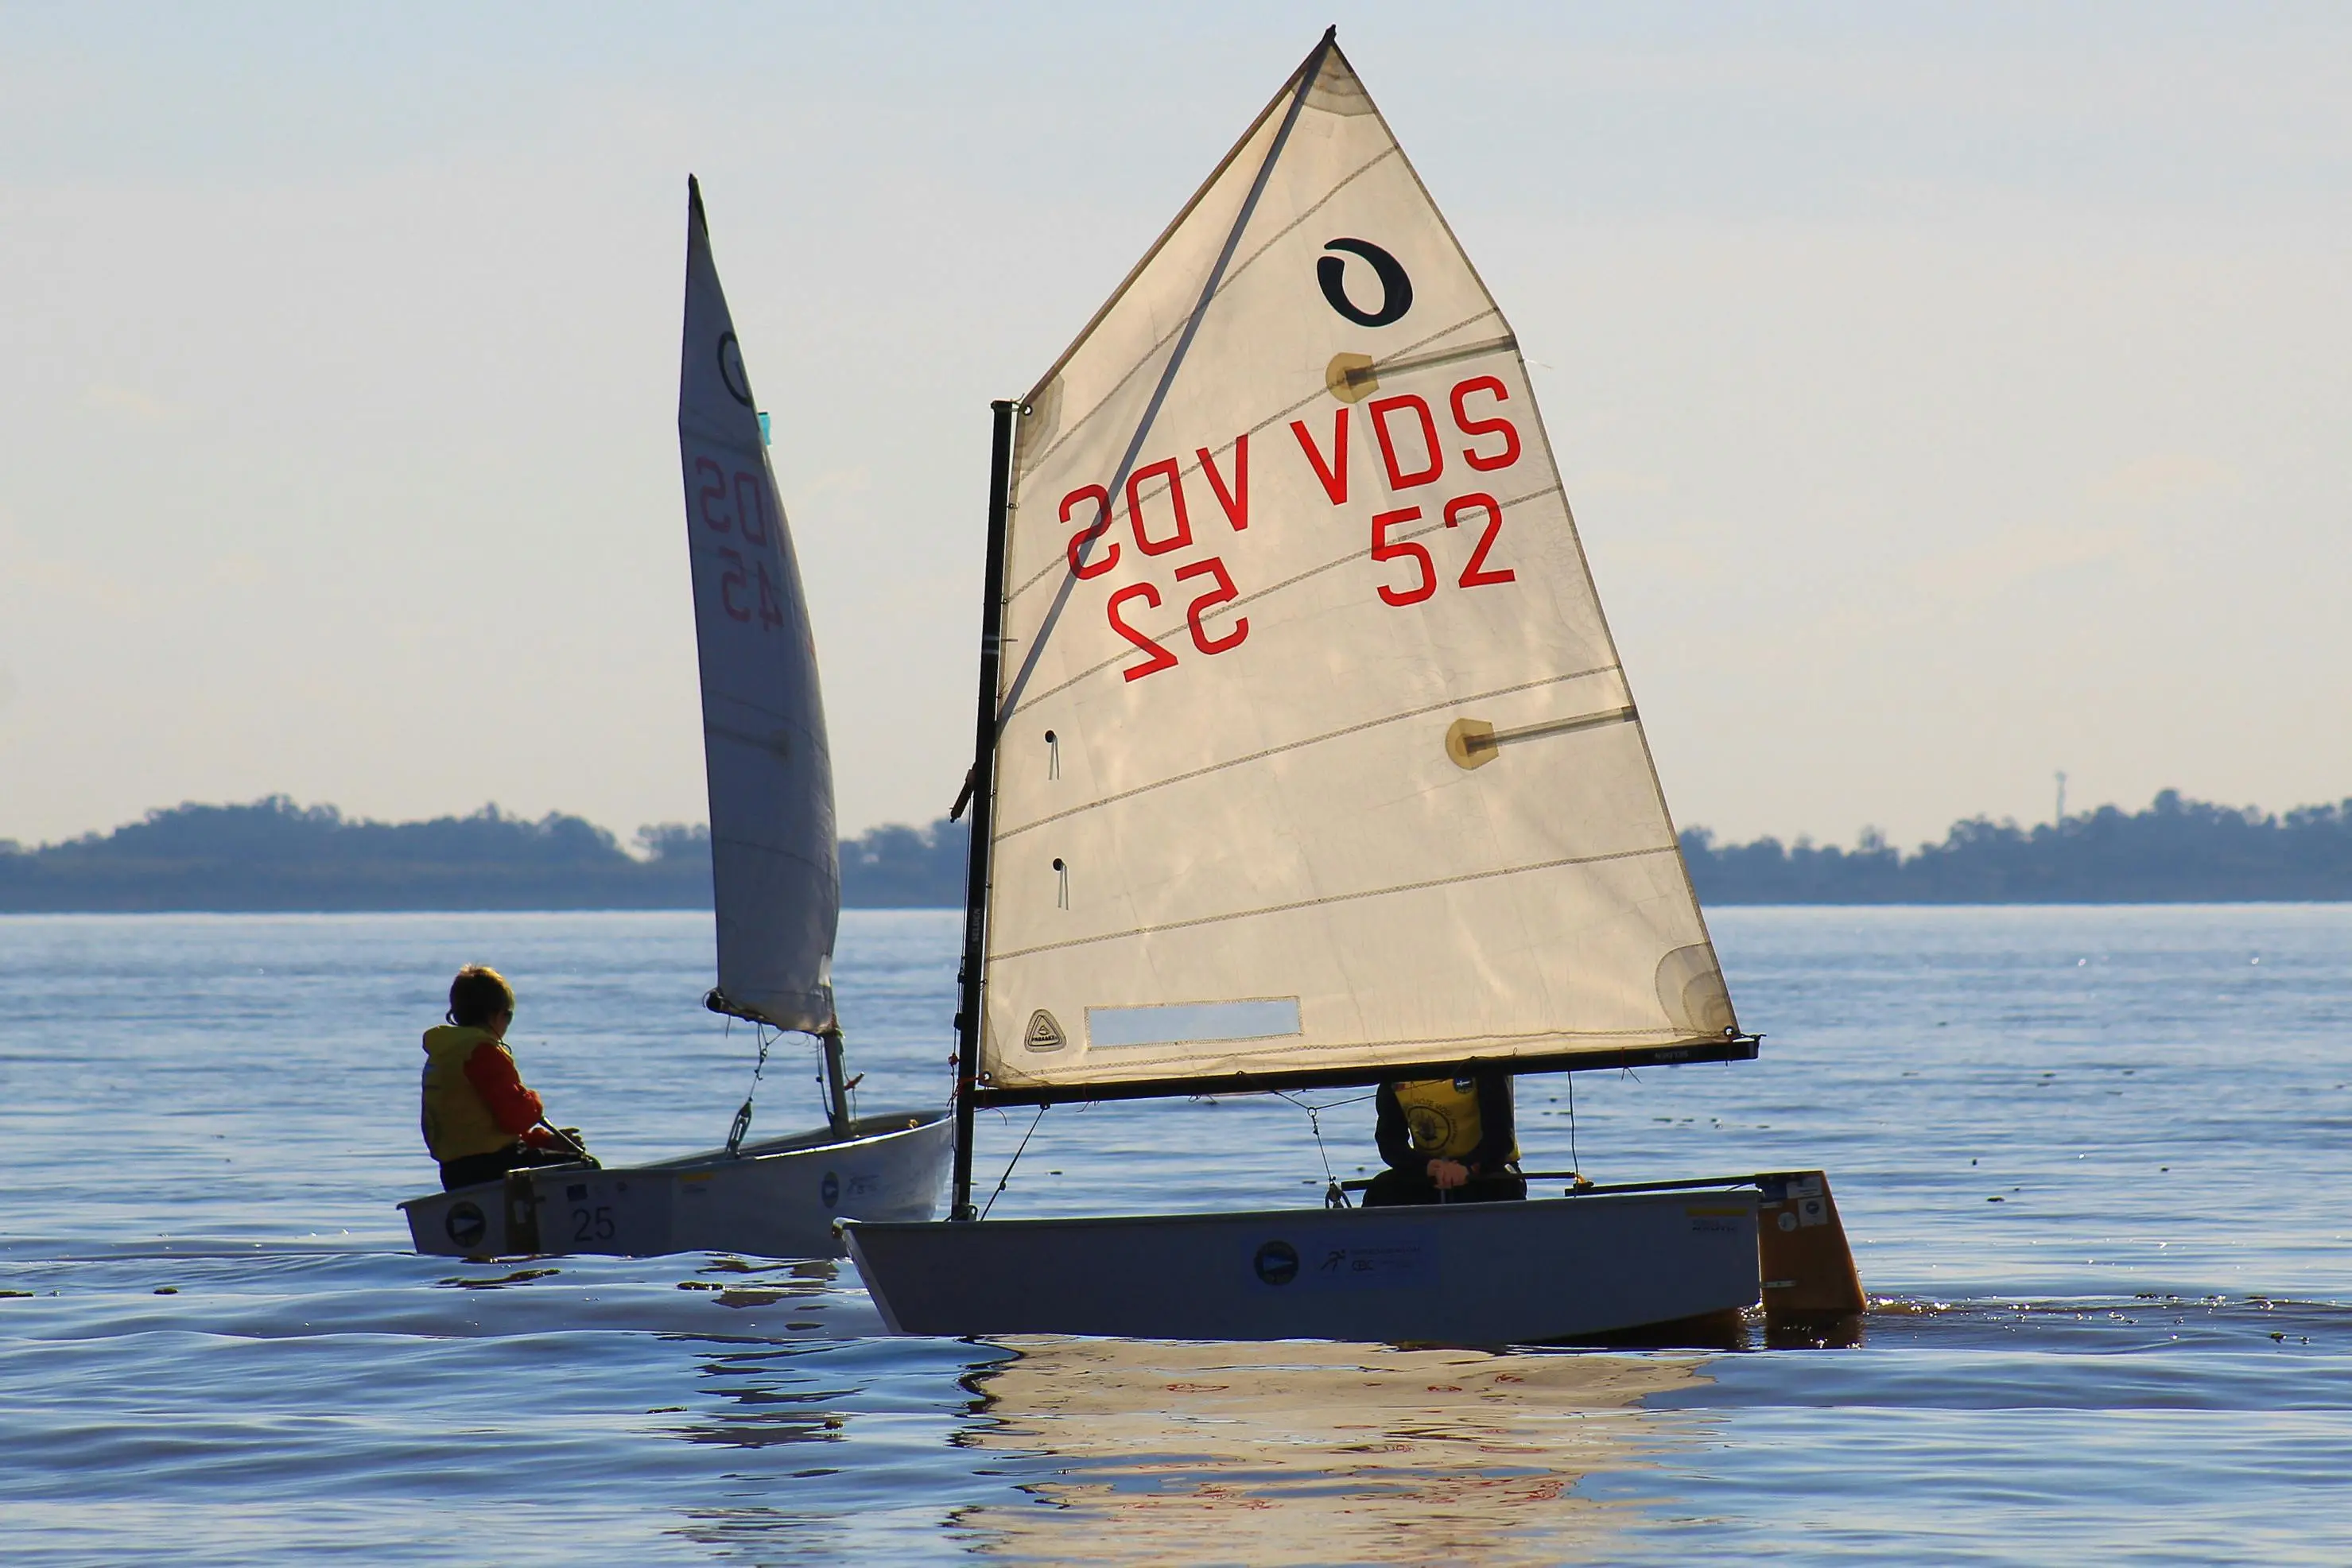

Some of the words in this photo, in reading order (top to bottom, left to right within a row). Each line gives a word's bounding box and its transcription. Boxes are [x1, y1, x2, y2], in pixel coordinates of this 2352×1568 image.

[1290, 375, 1522, 506] VDS
[1370, 492, 1516, 607] 52
[572, 1205, 615, 1242] 25
